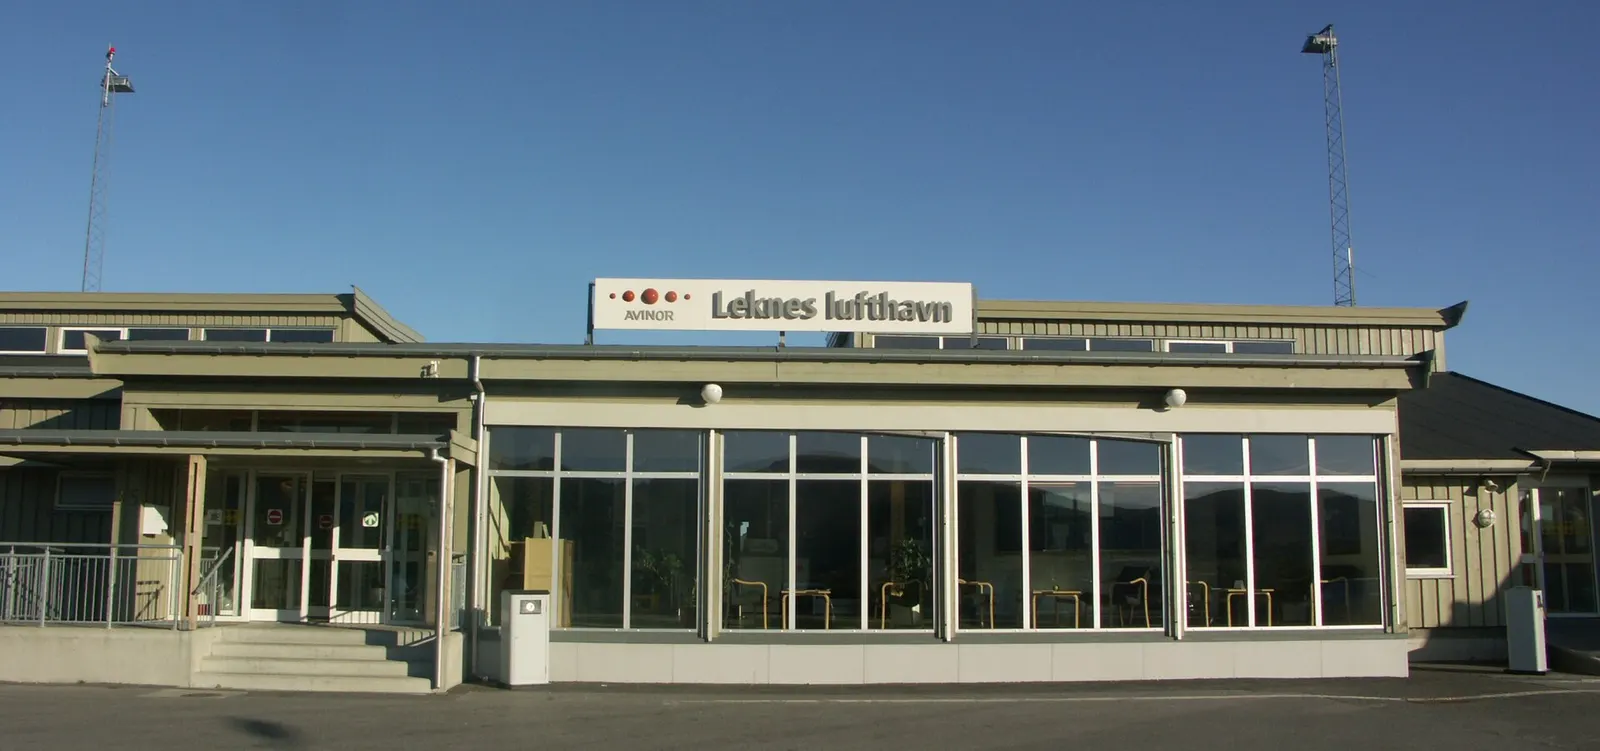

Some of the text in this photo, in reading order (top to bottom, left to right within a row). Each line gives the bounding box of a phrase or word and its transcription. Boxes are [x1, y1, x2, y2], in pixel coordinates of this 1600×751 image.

[624, 310, 674, 321] AVINOR
[711, 289, 953, 323] Leknes lufthavn
